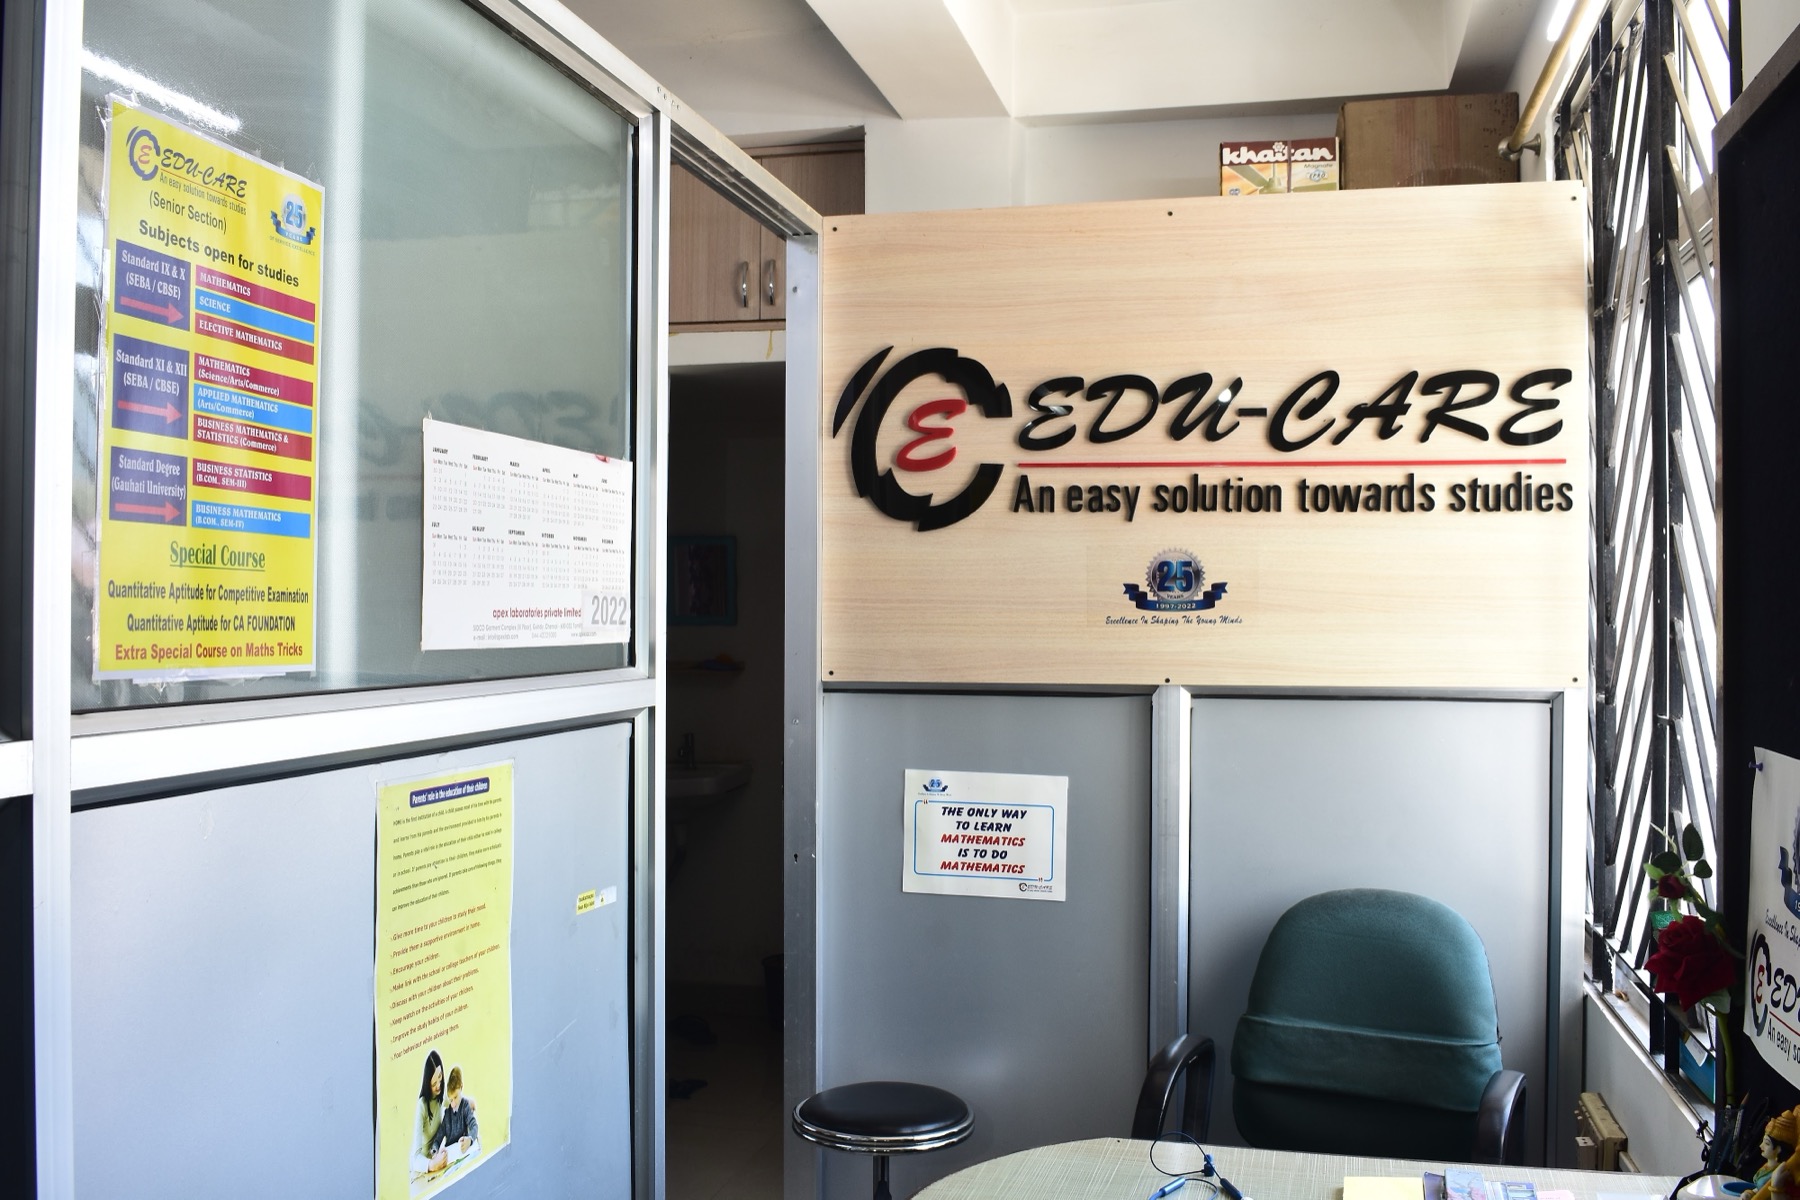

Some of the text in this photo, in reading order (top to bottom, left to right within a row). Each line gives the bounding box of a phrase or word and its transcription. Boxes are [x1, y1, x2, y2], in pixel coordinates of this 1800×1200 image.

[1223, 142, 1333, 164] khaitan
[161, 149, 247, 197] EDU-CARE
[160, 172, 246, 215] An easy solution towards studies
[150, 190, 227, 234] (Senior Section)
[286, 201, 302, 227] 25
[139, 220, 299, 286] Subjects open for studies
[122, 250, 185, 280] Standard IX & X
[126, 274, 150, 290] (SEBA
[158, 282, 180, 300] CBSE)
[200, 273, 250, 296] MATHEMATICS
[200, 296, 230, 313] SCIENCE
[200, 320, 282, 350] ELECTIVE MATHEMATICS
[116, 350, 187, 376] Standard XI & XII
[199, 357, 250, 376] MATHEMATICS
[124, 372, 148, 389] (SEBA
[155, 379, 179, 395] CBSE)
[199, 369, 280, 396] (Science/Arts/Commerce)
[198, 387, 278, 413] APPLIED MATHEMATICS
[198, 399, 254, 419] (Arts/Commerce)
[1018, 368, 1573, 453] EDU-CARE
[197, 430, 276, 452] STATISTICS (Commerce)
[198, 418, 288, 443] BUSINESS MATHEMATICS &
[119, 455, 180, 476] Standard Degree
[197, 463, 272, 481] BUSINESS STATISTICS
[112, 477, 186, 500] (Gauhati University)
[1013, 472, 1573, 522] An easy solution towards studies
[196, 505, 281, 521] BUSINESS MATHEMATICS
[171, 541, 265, 568] Special Course
[1157, 561, 1194, 592] 25
[108, 580, 308, 604] Quantitative Aptitude for Competitive Examination
[493, 596, 627, 625] apex laboratories private limited 2022
[1106, 616, 1138, 625] Excellence
[1151, 616, 1178, 625] Shaping
[1182, 616, 1192, 624] The
[1196, 616, 1216, 625] Young
[1219, 616, 1242, 624] Minds
[128, 614, 295, 635] Quantitative Aptitude for CA FOUNDATION
[116, 642, 302, 662] Extra Special Course on Maths Tricks
[412, 793, 427, 804] Parents'
[436, 791, 438, 799] in
[446, 786, 462, 797] education
[463, 785, 466, 793] of
[475, 782, 487, 791] children
[930, 779, 941, 787] 25
[942, 807, 1027, 819] THE ONLY WAY
[956, 821, 1012, 832] TO LEARN
[941, 834, 1025, 846] MATHEMATICS
[958, 849, 1007, 859] IS TO DO
[940, 861, 1025, 873] MATHEMATICS
[1767, 1018, 1775, 1043] An
[1776, 1031, 1791, 1061] easy
